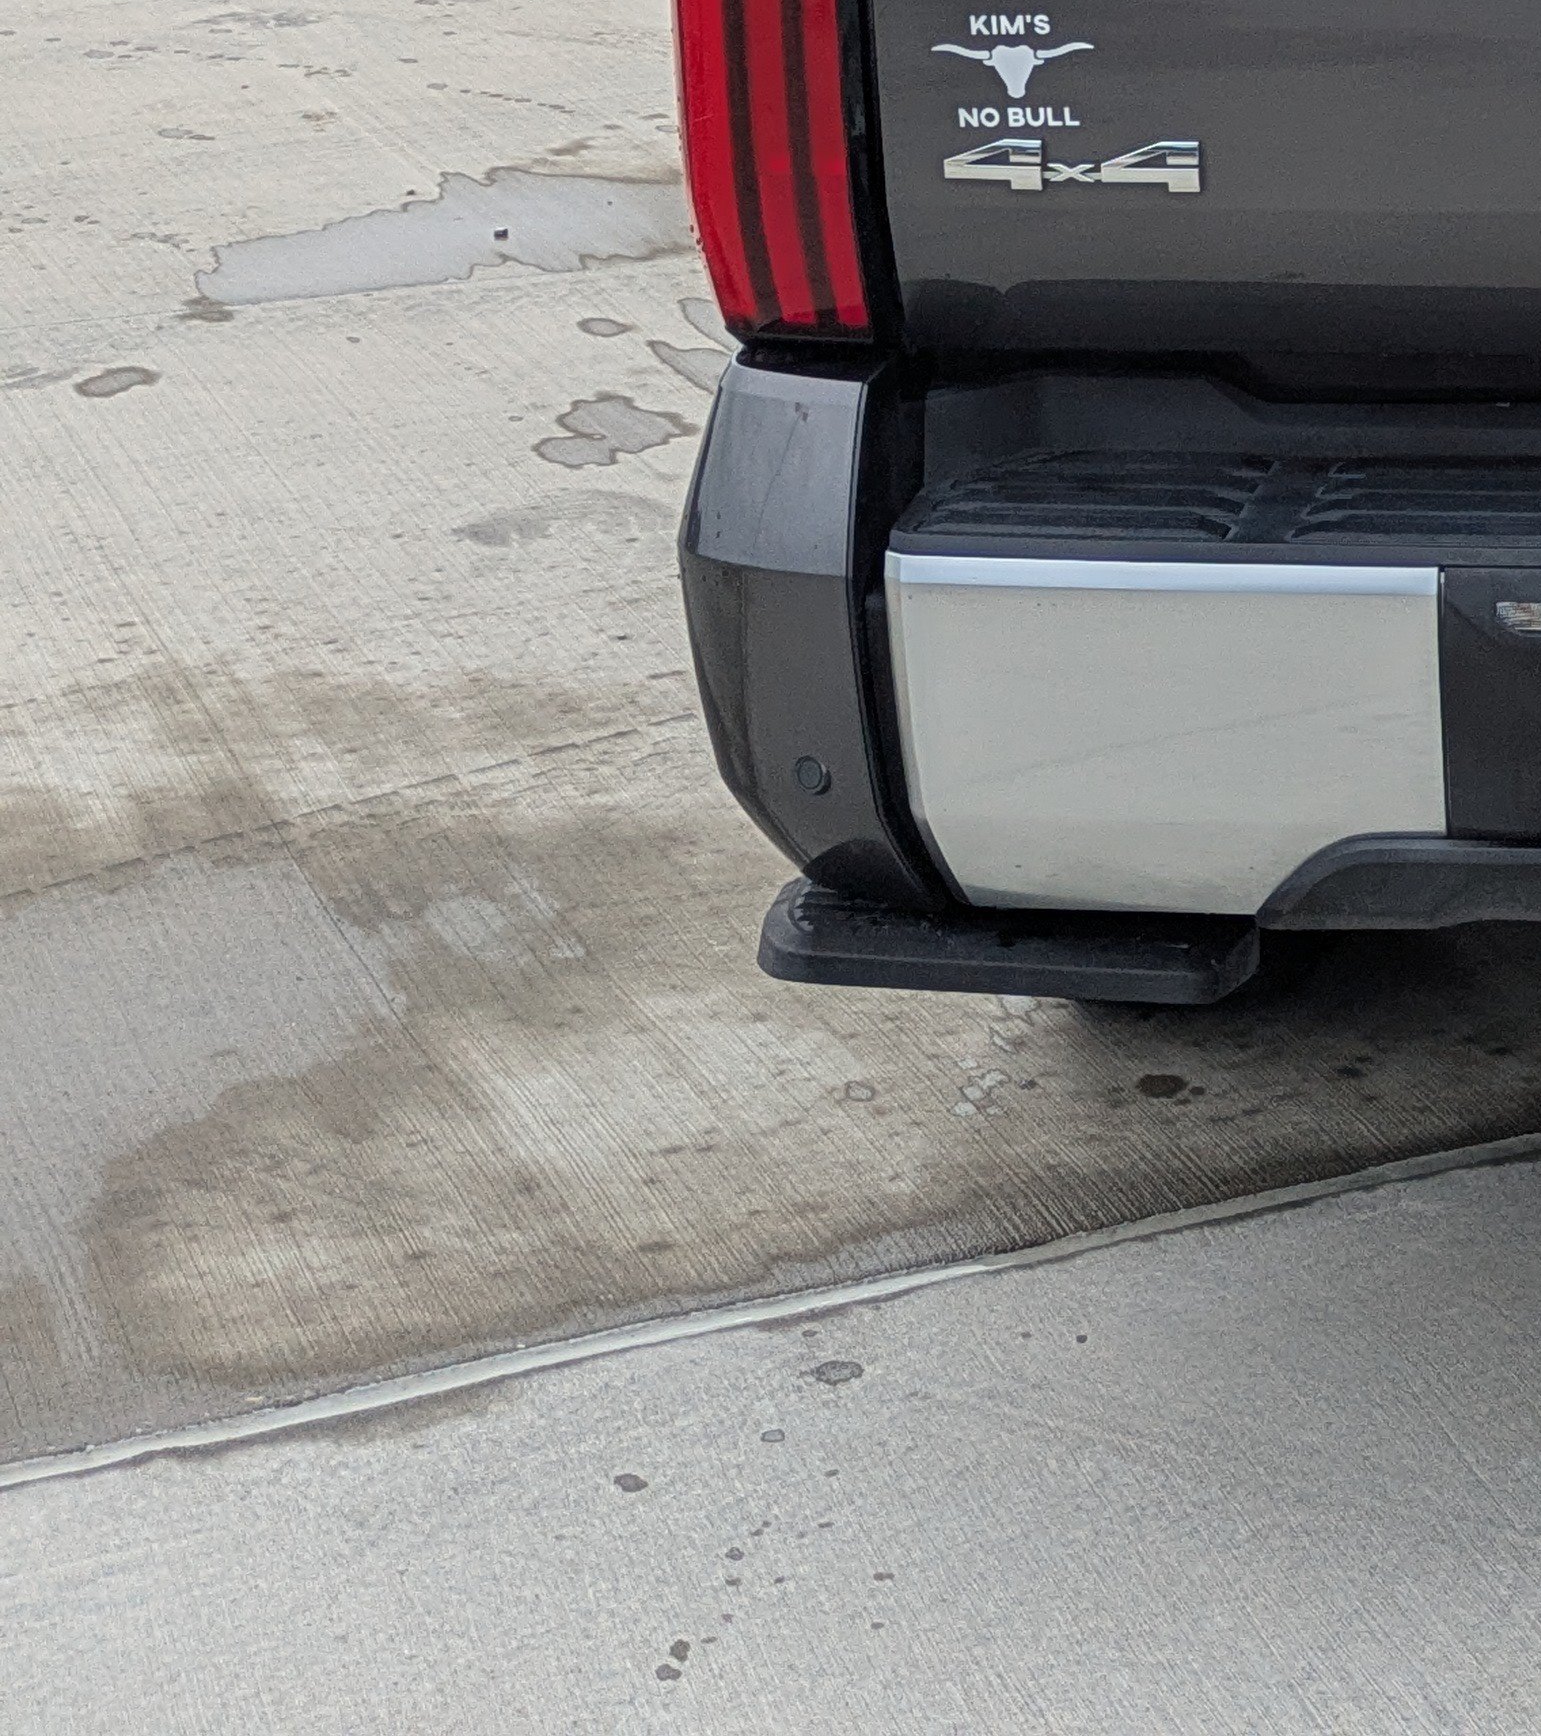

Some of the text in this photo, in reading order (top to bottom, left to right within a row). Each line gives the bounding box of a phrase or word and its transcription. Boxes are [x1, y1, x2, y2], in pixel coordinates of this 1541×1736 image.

[969, 14, 1050, 36] KIM'S
[958, 106, 1081, 128] NO BULL
